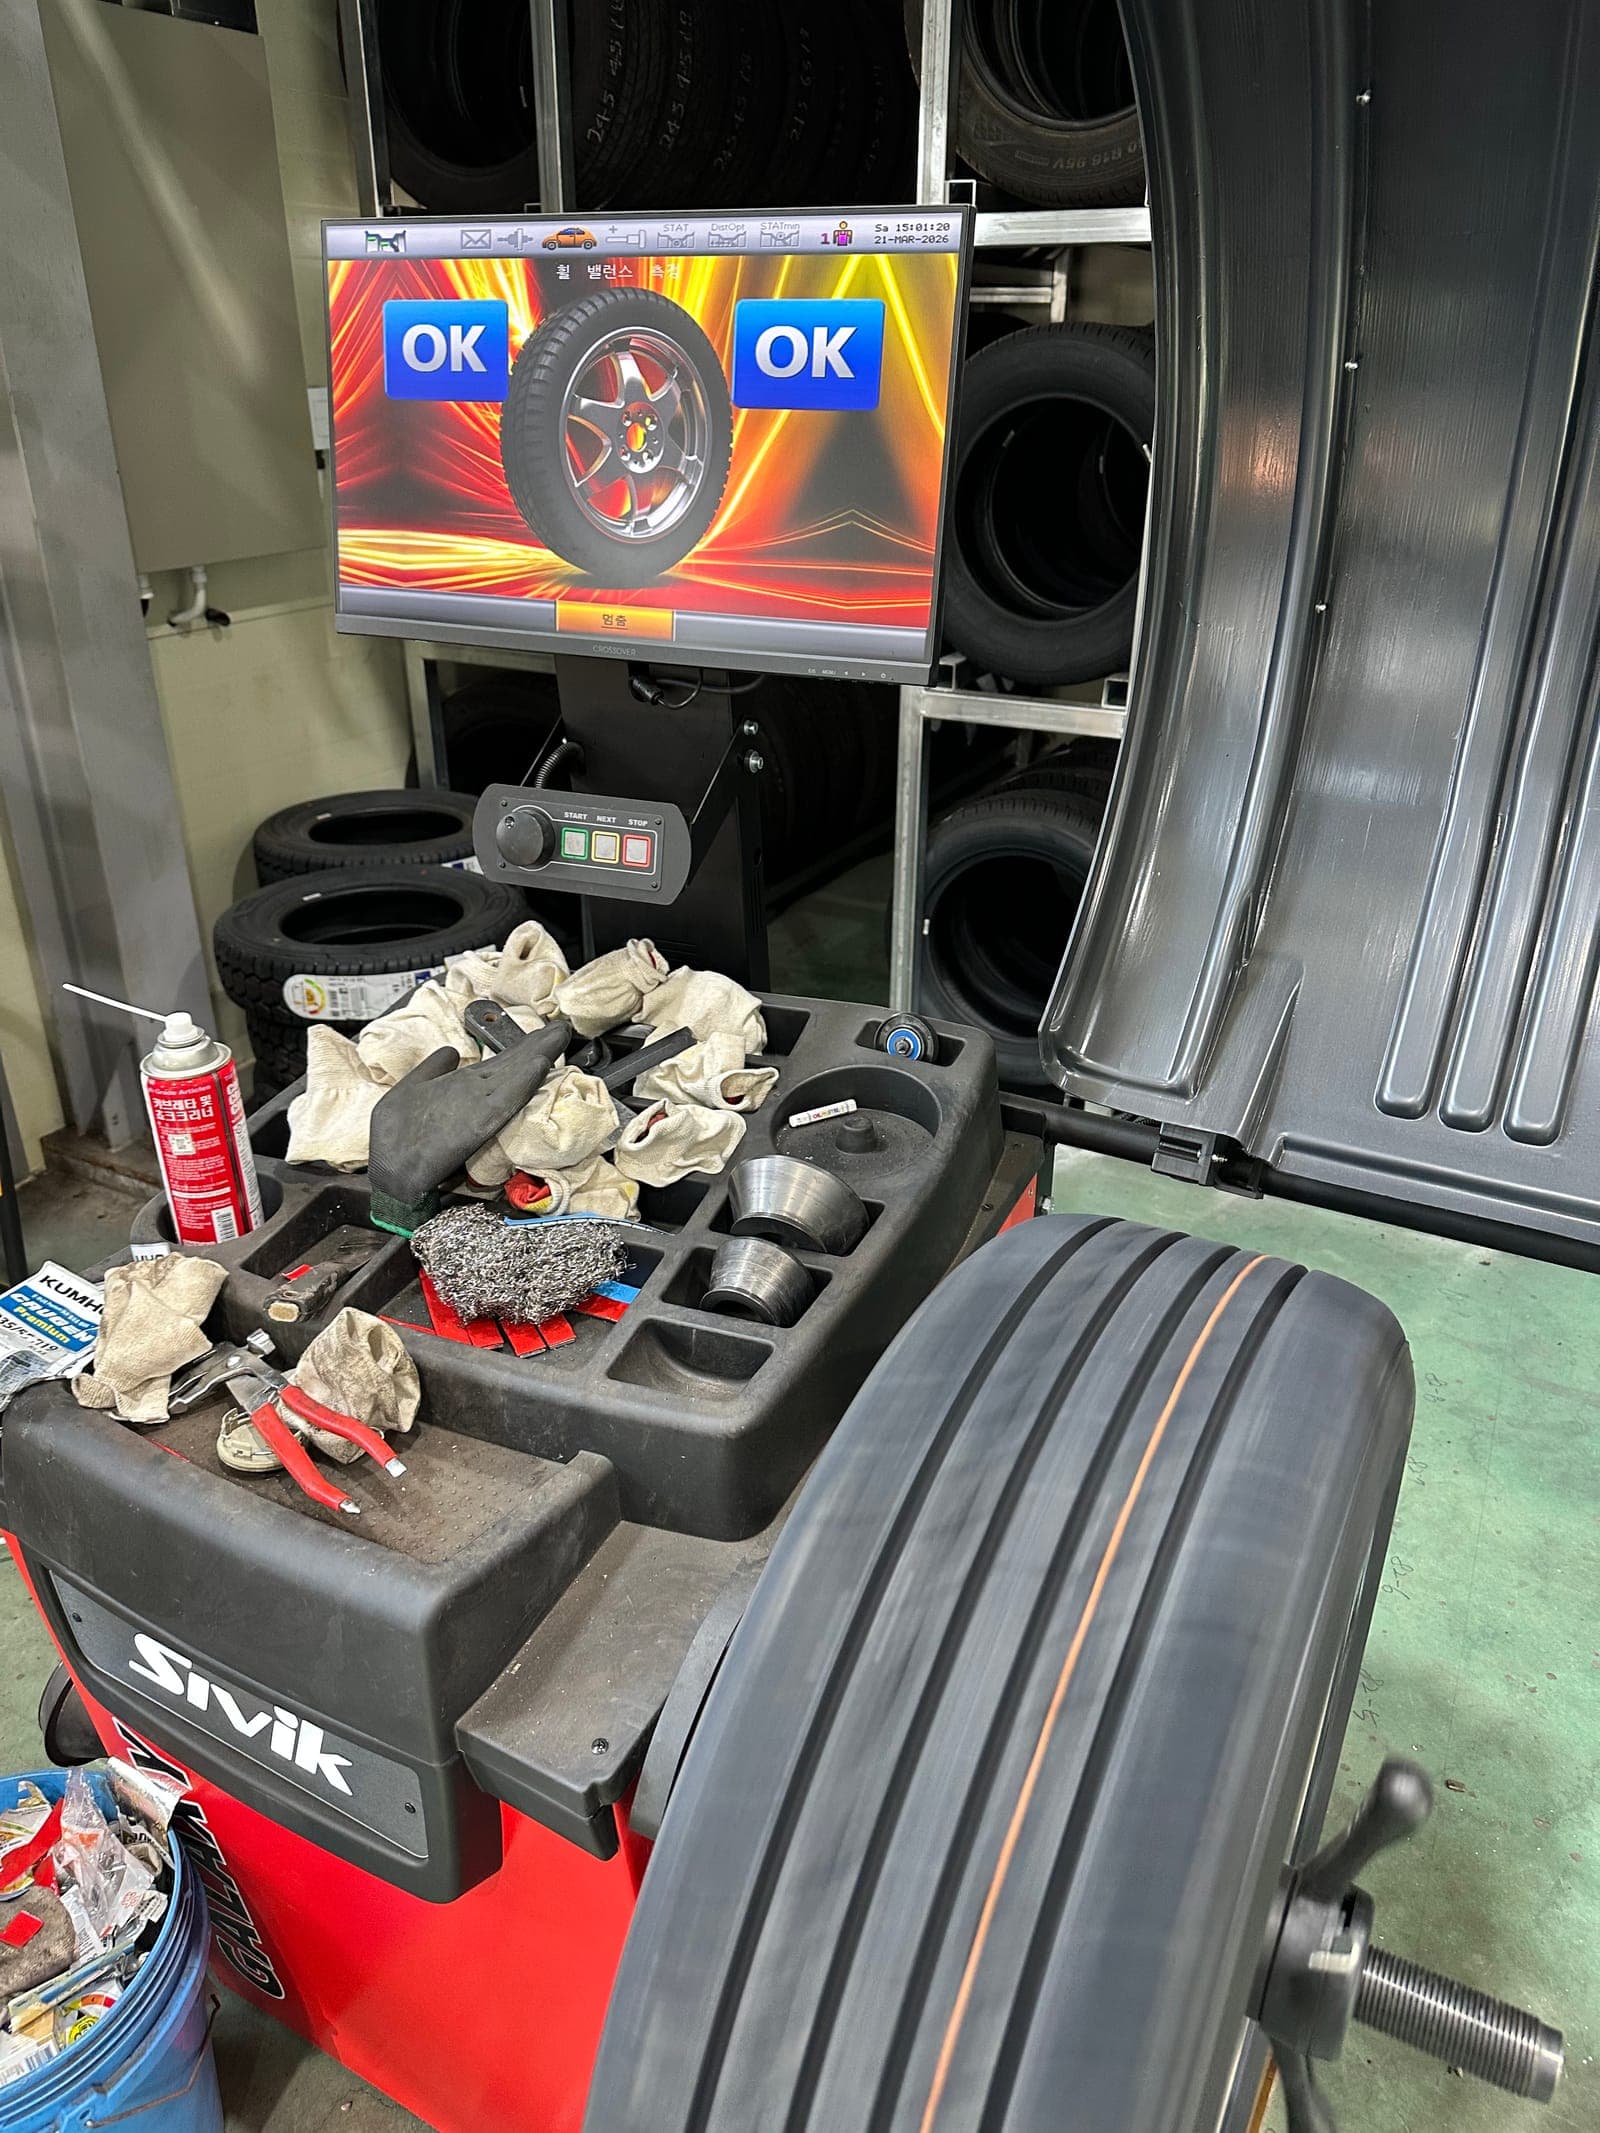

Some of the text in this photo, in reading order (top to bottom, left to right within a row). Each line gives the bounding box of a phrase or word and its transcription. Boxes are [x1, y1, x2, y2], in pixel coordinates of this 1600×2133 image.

[586, 90, 615, 143] 245
[608, 39, 624, 76] 45
[659, 101, 685, 150] 245
[663, 223, 689, 233] STAT
[874, 222, 950, 233] Sa 15:01:20
[874, 234, 950, 245] 21-MAR-2026
[556, 264, 570, 280] 휠
[587, 264, 633, 280] 밸런스
[402, 324, 488, 374] OK
[754, 326, 857, 378] OK
[602, 613, 627, 628] 멈춤
[564, 811, 648, 828] START NEXT STOP
[13, 1305, 70, 1344] Premium
[129, 1633, 353, 1796] Sivik
